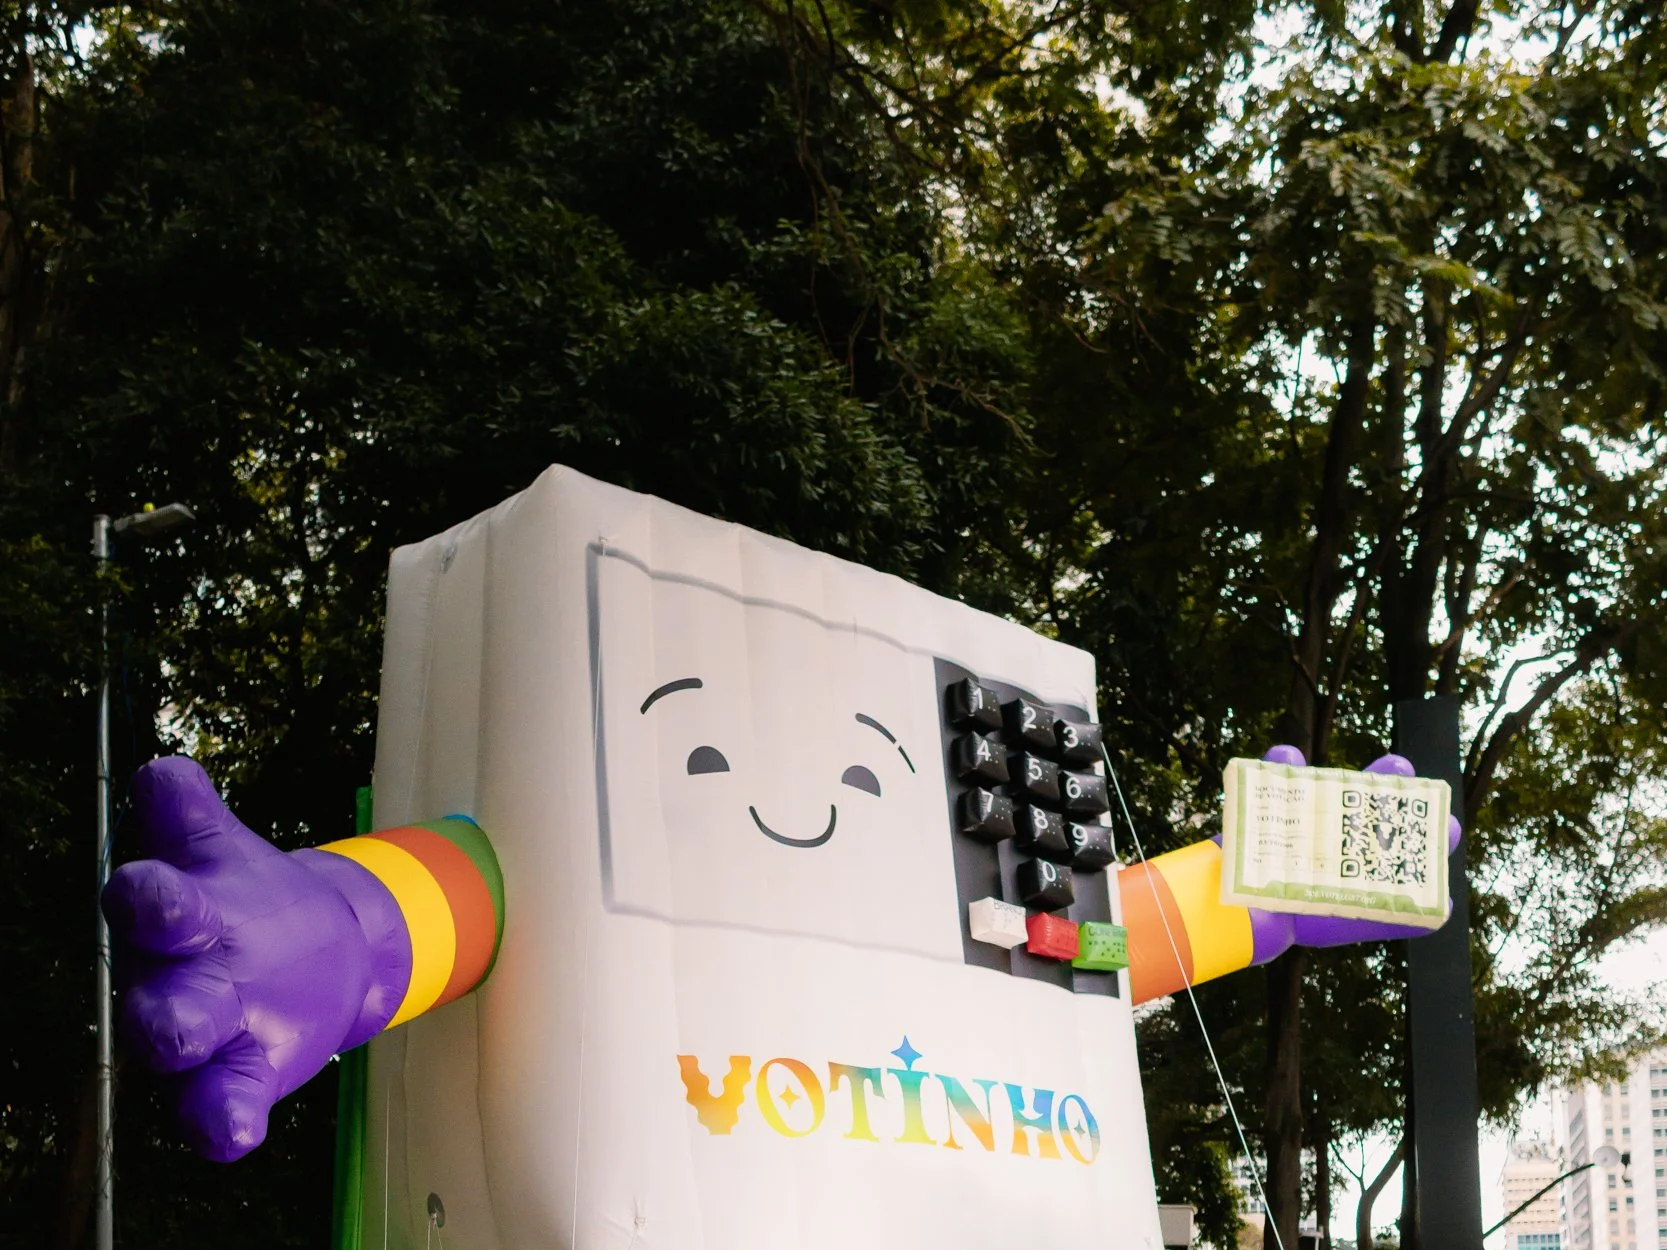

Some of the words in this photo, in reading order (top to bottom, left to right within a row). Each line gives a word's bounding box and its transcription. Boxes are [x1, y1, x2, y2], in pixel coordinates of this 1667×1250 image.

[974, 687, 982, 709] 1
[1023, 706, 1037, 729] 2
[1063, 726, 1079, 748] 3
[976, 740, 991, 761] 4
[1028, 758, 1042, 780] 5
[1065, 777, 1081, 799] 6
[982, 791, 994, 812] 7
[1034, 808, 1048, 829] 8
[1071, 824, 1088, 846] 9
[1042, 861, 1056, 882] 0
[676, 1034, 1101, 1166] VOTINHO
